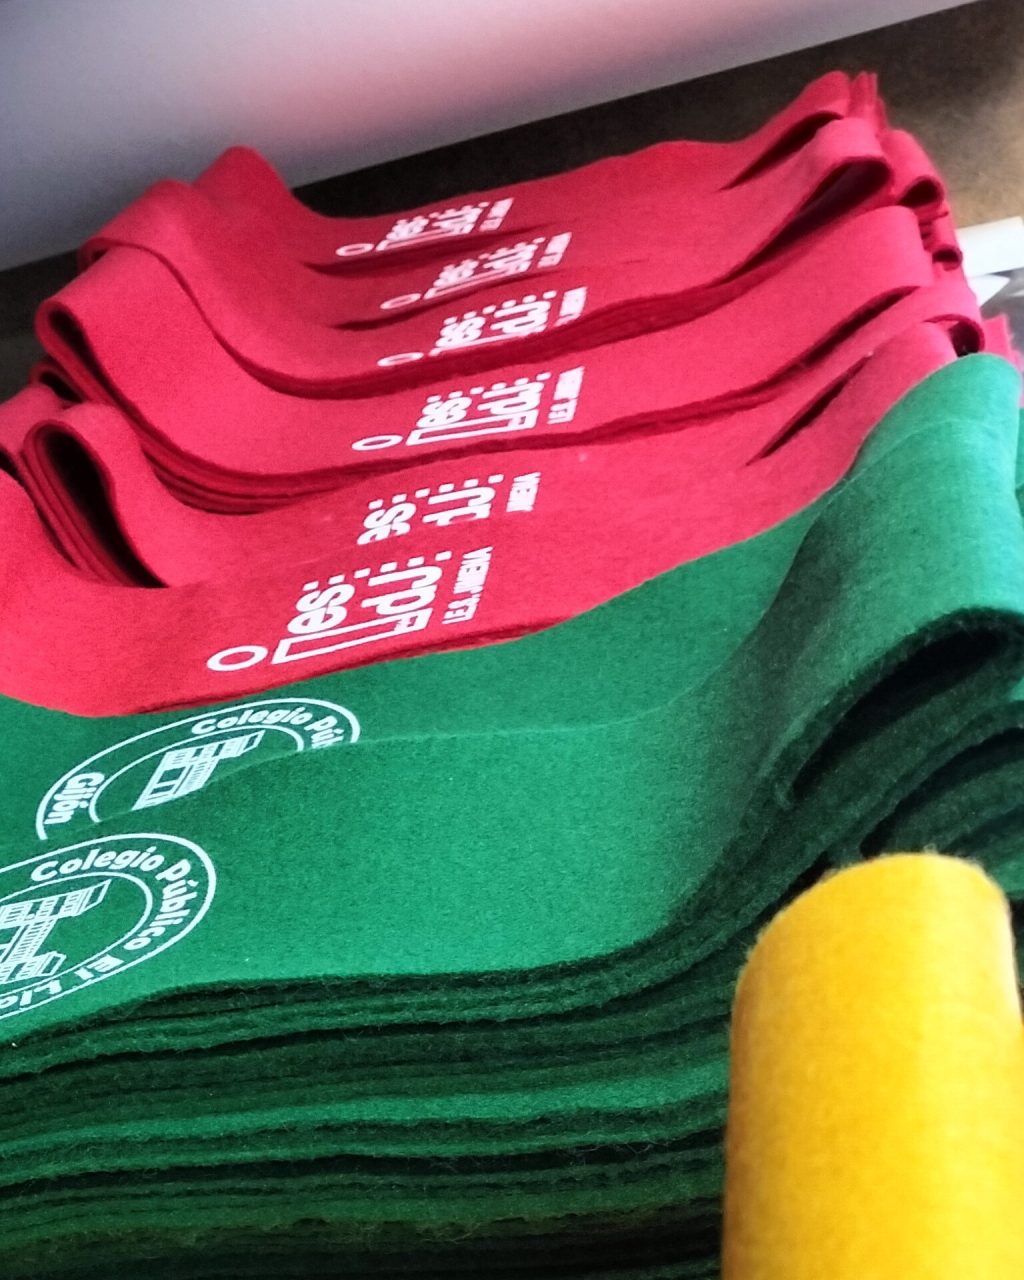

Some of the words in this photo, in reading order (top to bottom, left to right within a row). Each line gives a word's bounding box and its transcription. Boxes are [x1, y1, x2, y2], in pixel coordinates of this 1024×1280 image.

[191, 706, 313, 734] Colegio
[44, 772, 105, 825] Gijón
[31, 846, 165, 881] Colegio
[123, 859, 199, 950] Público
[74, 954, 125, 980] El
